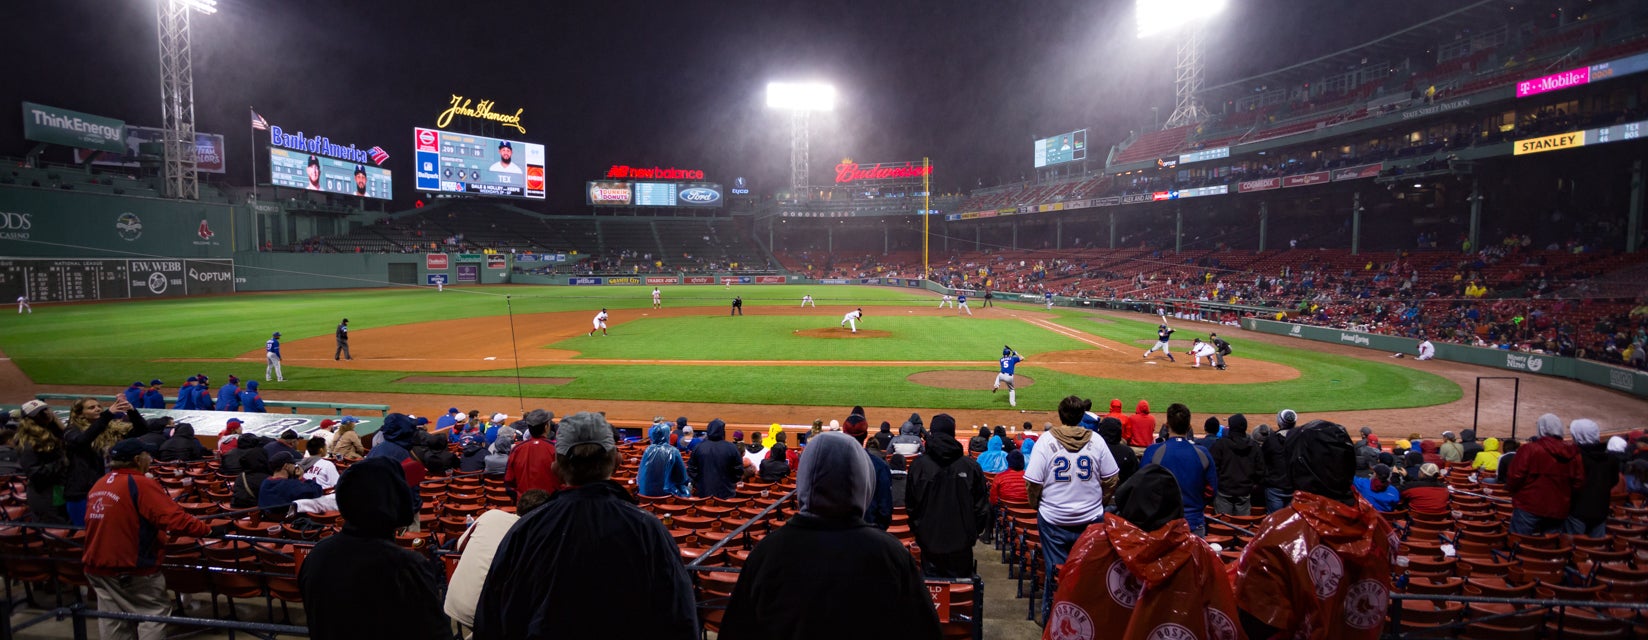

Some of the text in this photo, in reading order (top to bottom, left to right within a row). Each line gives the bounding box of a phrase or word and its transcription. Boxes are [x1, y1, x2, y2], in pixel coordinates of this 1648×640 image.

[437, 94, 526, 134] John Hancock
[32, 109, 120, 140] ThinkEnergy
[1625, 123, 1639, 131] TEX
[1624, 131, 1639, 139] BOS
[271, 125, 367, 163] Bank of America
[1522, 135, 1576, 152] STANLEY
[834, 161, 933, 183] Budweiser
[498, 174, 512, 183] TEX
[687, 190, 712, 201] Ford
[152, 261, 182, 272] WEBB
[199, 271, 232, 282] OPTUM
[1507, 353, 1526, 363] Ninety
[1003, 360, 1009, 369] 5
[1506, 359, 1526, 369] Nine
[1054, 455, 1094, 483] 29
